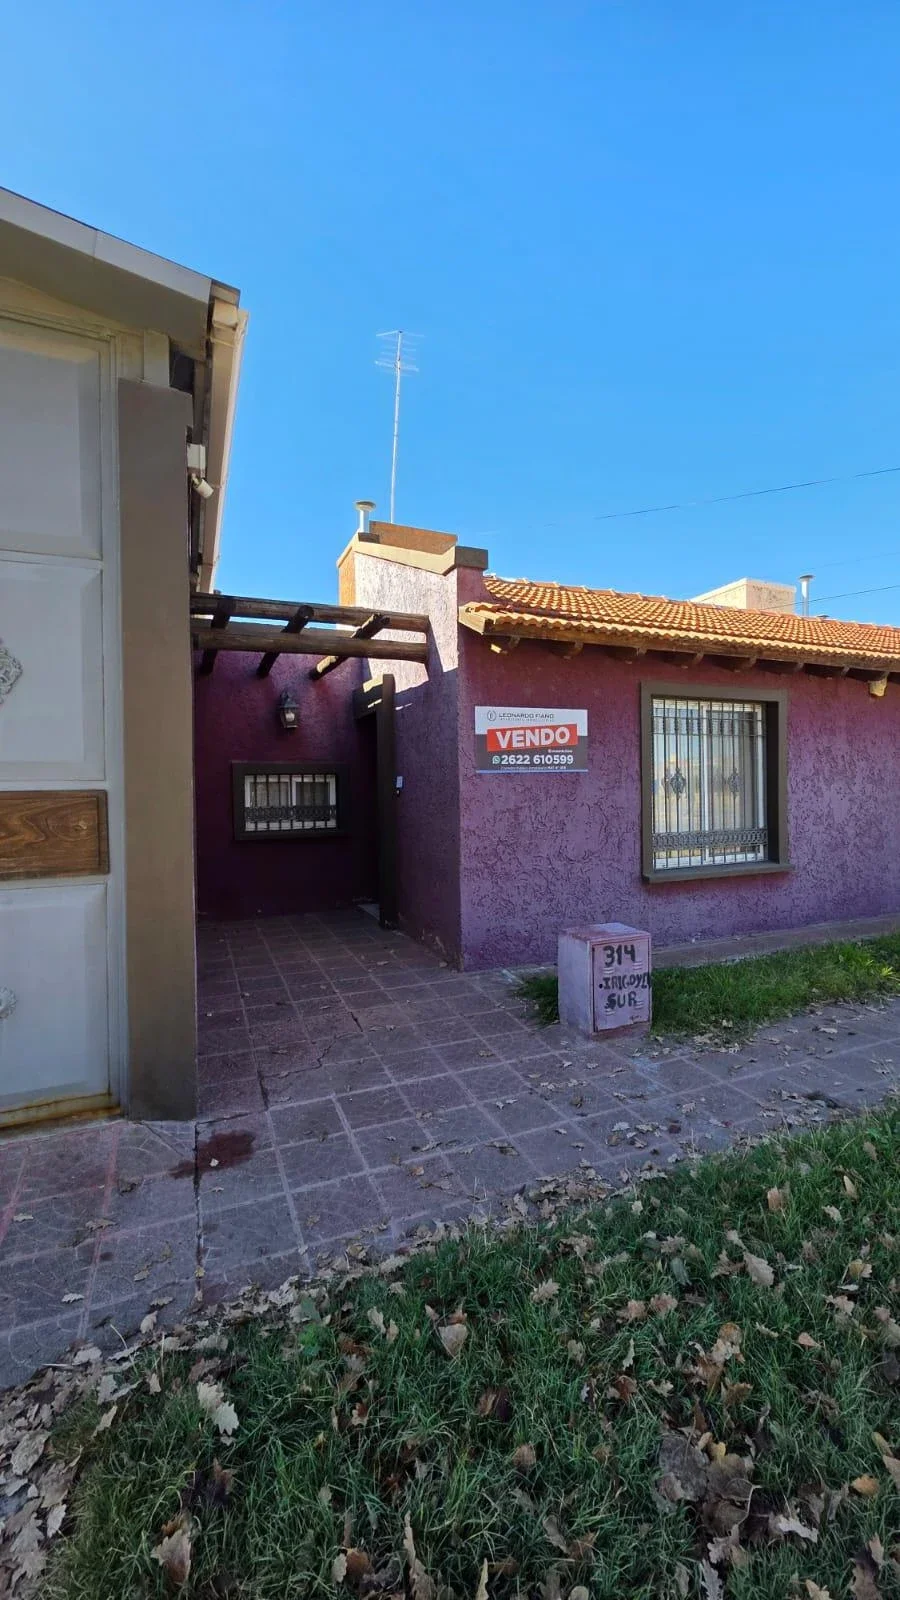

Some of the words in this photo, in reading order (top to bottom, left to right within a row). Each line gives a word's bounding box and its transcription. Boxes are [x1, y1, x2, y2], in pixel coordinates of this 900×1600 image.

[496, 727, 570, 749] VENDO
[501, 754, 531, 765] 2622
[533, 754, 573, 765] 610599
[603, 944, 636, 966] 314
[605, 991, 637, 1010] SUR
